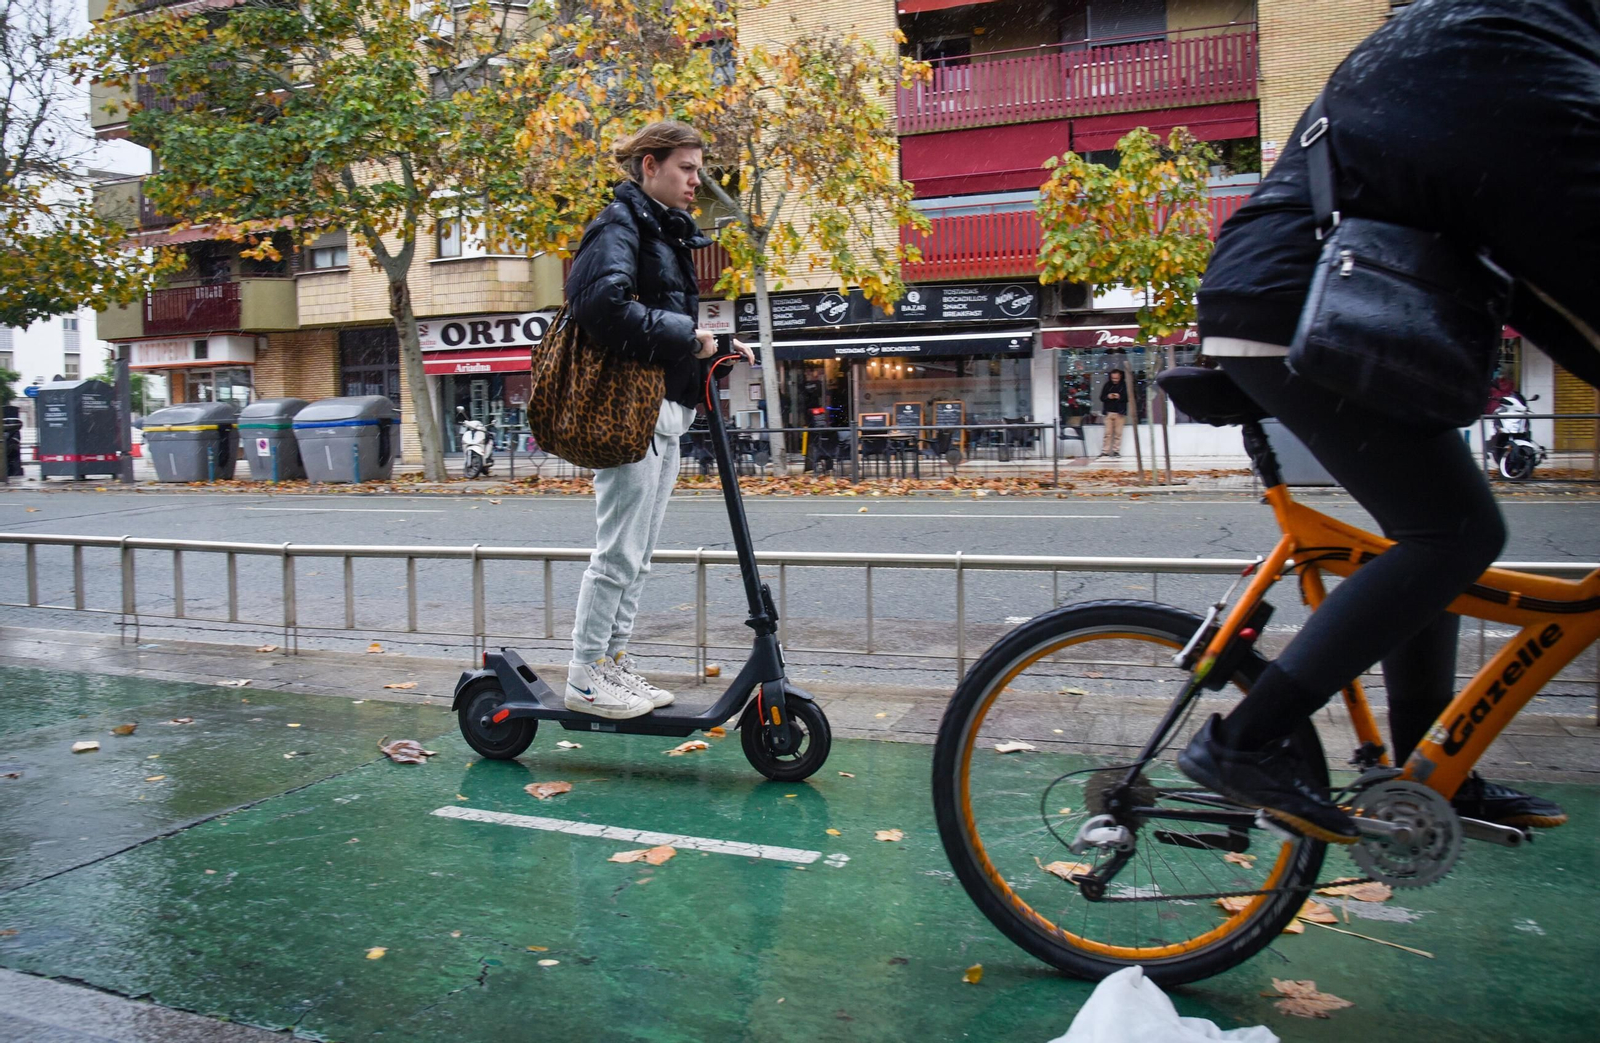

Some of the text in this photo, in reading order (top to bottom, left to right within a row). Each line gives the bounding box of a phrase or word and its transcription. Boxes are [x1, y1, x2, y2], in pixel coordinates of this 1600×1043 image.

[942, 295, 988, 303] BOCADILLOS
[1011, 294, 1034, 309] STOP
[772, 304, 811, 313] BOCADILLOS
[901, 304, 927, 312] BAZAR
[772, 312, 794, 320] SNACK
[942, 310, 983, 318] BREAKFAST
[772, 318, 807, 327] BREAKFAST
[441, 316, 555, 347] ORTO
[454, 362, 491, 373] Ariadna
[1442, 623, 1564, 757] Gazelle
